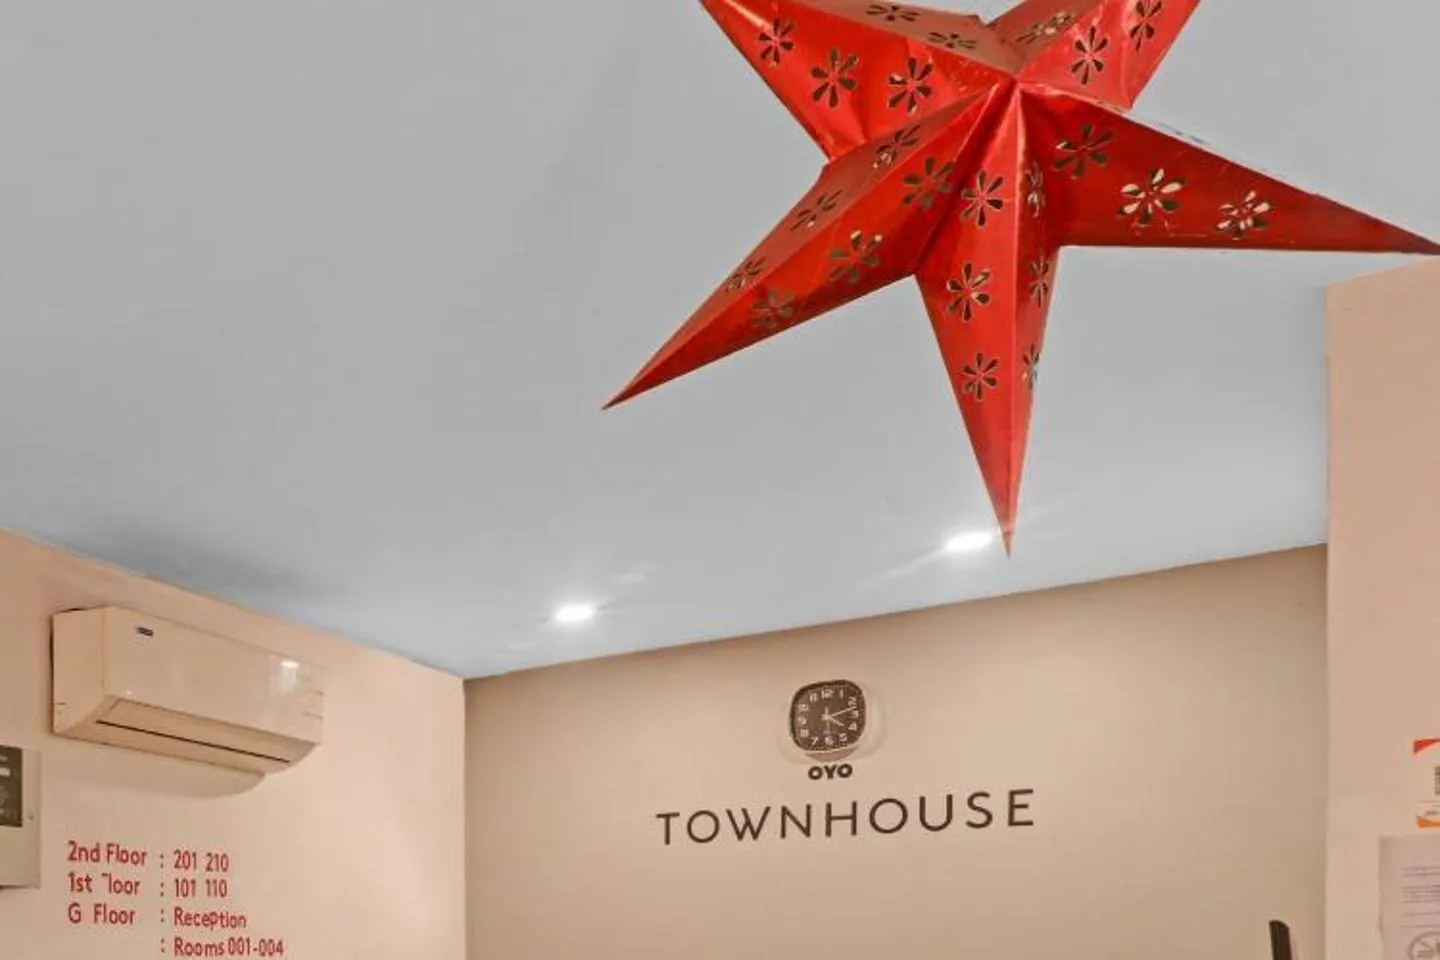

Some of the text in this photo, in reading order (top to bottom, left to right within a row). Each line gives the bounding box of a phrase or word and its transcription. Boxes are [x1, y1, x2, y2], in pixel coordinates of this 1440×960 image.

[808, 763, 853, 780] OYO
[656, 788, 1034, 846] TOWNHOUSE
[67, 840, 101, 863] 2nd
[106, 842, 148, 866] Floor
[173, 848, 197, 871] 201
[205, 851, 230, 873] 210
[68, 871, 93, 893] 1st
[101, 872, 140, 896] loor
[174, 877, 196, 898] 101
[205, 878, 228, 898] 110
[68, 902, 81, 924] G
[93, 902, 136, 925] Floor
[173, 905, 247, 932] Reception
[174, 936, 225, 957] Rooms
